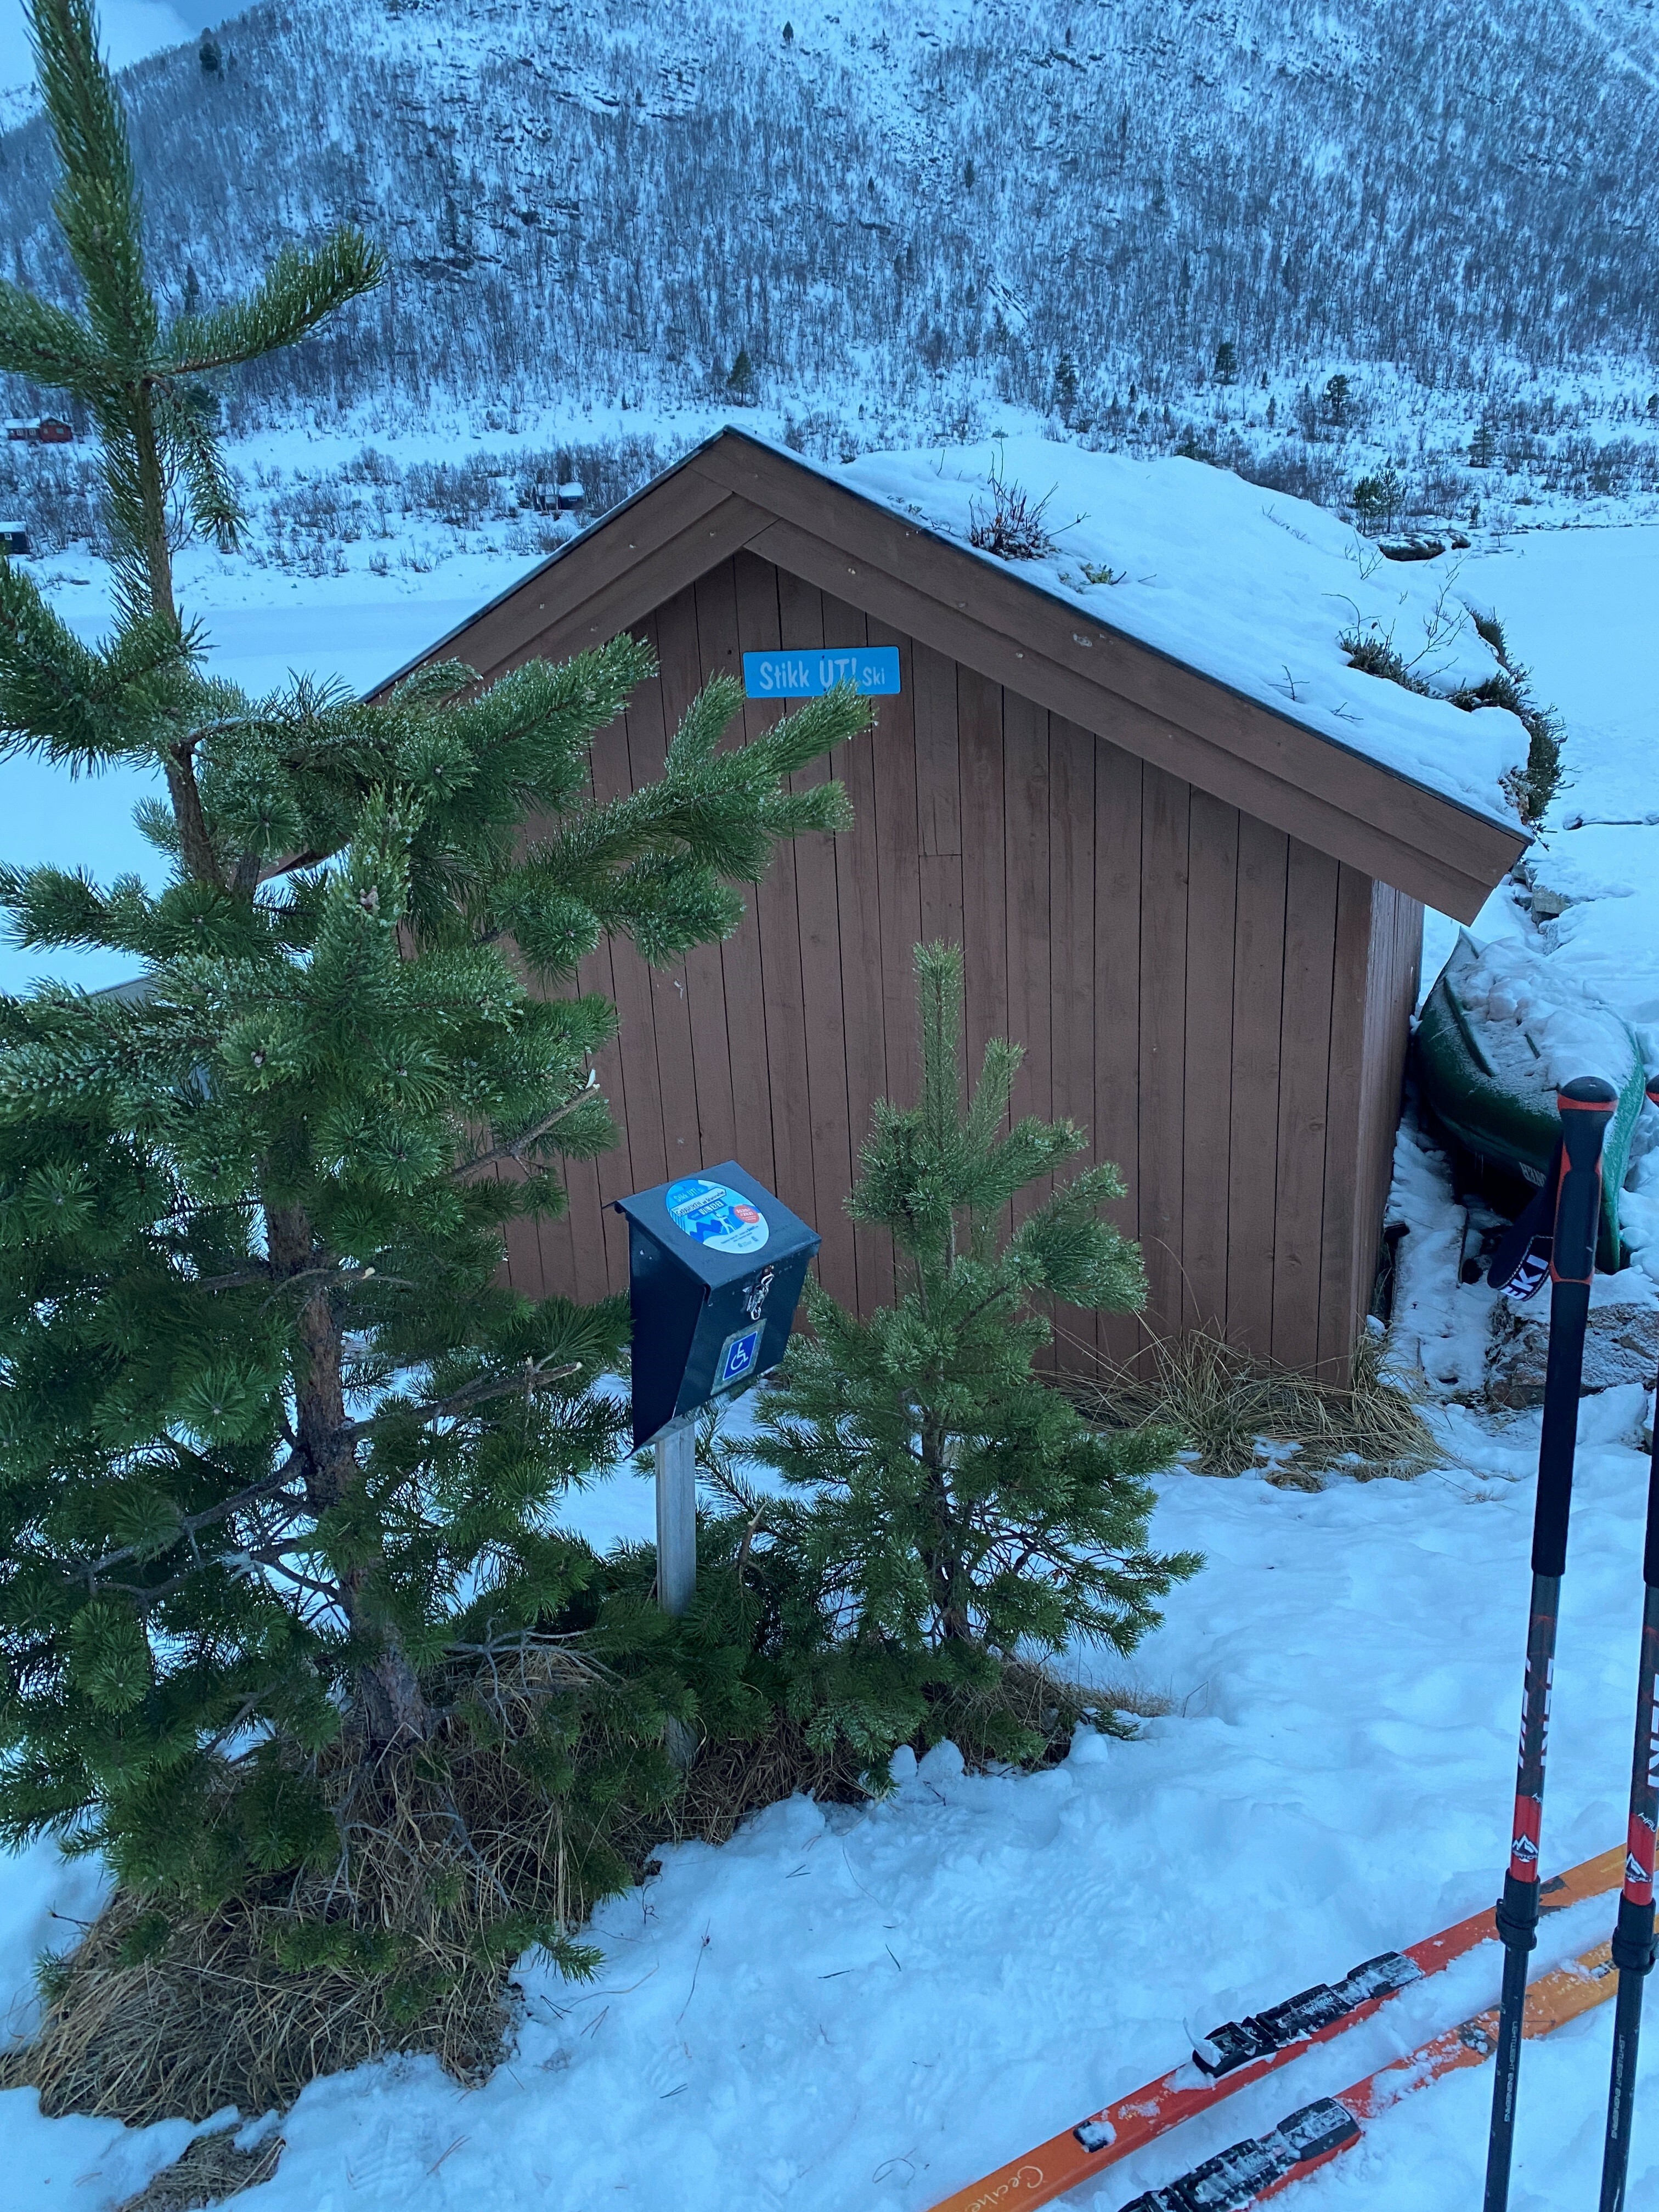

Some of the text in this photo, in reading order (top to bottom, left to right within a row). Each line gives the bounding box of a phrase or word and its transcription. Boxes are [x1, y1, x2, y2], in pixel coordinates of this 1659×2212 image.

[759, 660, 810, 690] Stikk
[819, 657, 857, 687] UT!
[960, 2165, 1043, 2212] Cecilie
